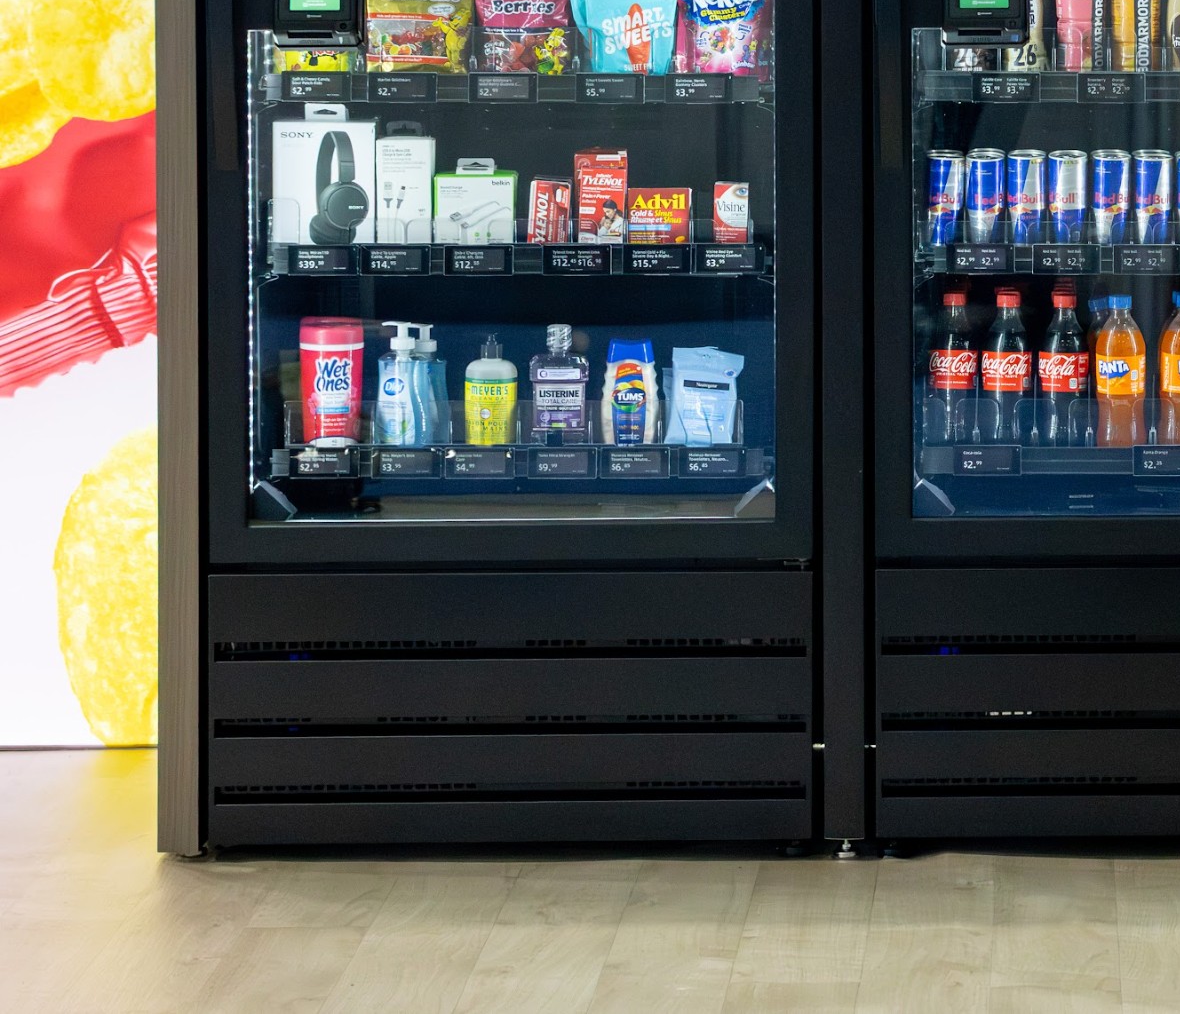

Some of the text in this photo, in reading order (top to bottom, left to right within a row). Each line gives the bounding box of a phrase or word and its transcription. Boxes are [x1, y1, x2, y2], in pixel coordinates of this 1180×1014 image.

[700, 7, 737, 18] Gummy
[709, 11, 745, 22] Clusters
[602, 7, 662, 35] SMART
[604, 22, 673, 54] SWEETS
[582, 176, 623, 186] TYLENOL
[630, 193, 686, 210] Advil
[716, 200, 745, 213] Visine
[318, 359, 351, 379] Wet
[1099, 360, 1130, 373] FANTA
[315, 377, 350, 391] Ones
[471, 386, 508, 395] MEYER'S
[539, 390, 579, 398] LISTERINE
[617, 392, 644, 402] TUMS
